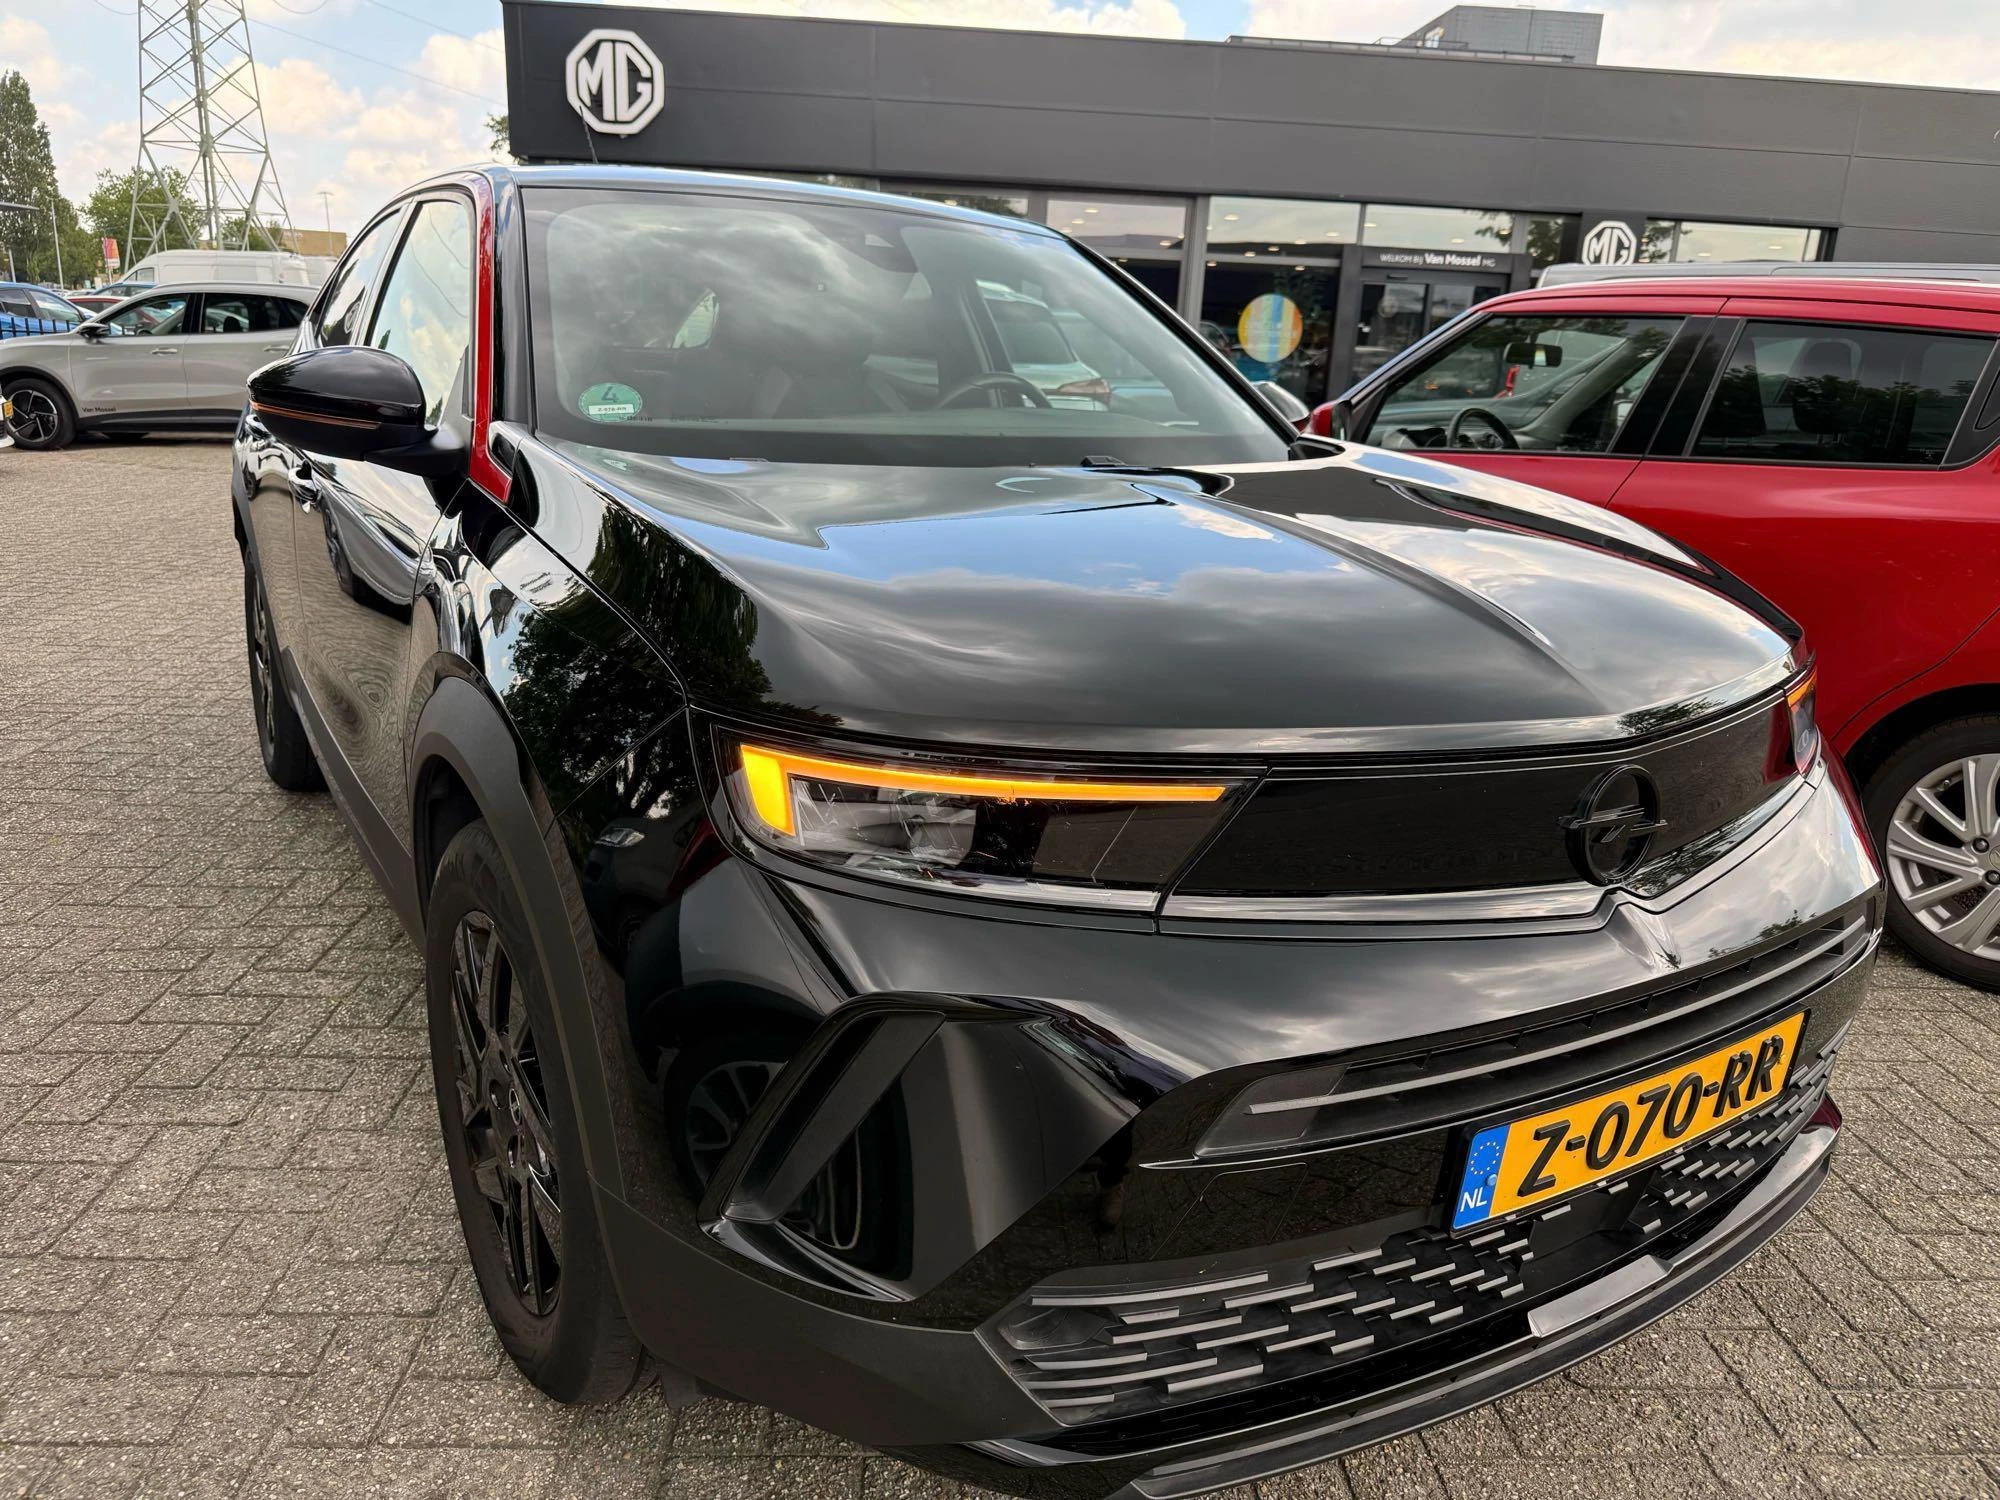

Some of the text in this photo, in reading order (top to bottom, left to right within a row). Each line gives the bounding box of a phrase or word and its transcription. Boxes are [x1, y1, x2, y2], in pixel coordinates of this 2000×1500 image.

[575, 39, 655, 123] MG
[1424, 252, 1444, 264] Van
[1444, 253, 1482, 267] Mossel
[1588, 226, 1631, 265] MG
[601, 385, 619, 403] 4
[1517, 1035, 1784, 1198] Z-070-RR
[1459, 1190, 1488, 1212] NL
